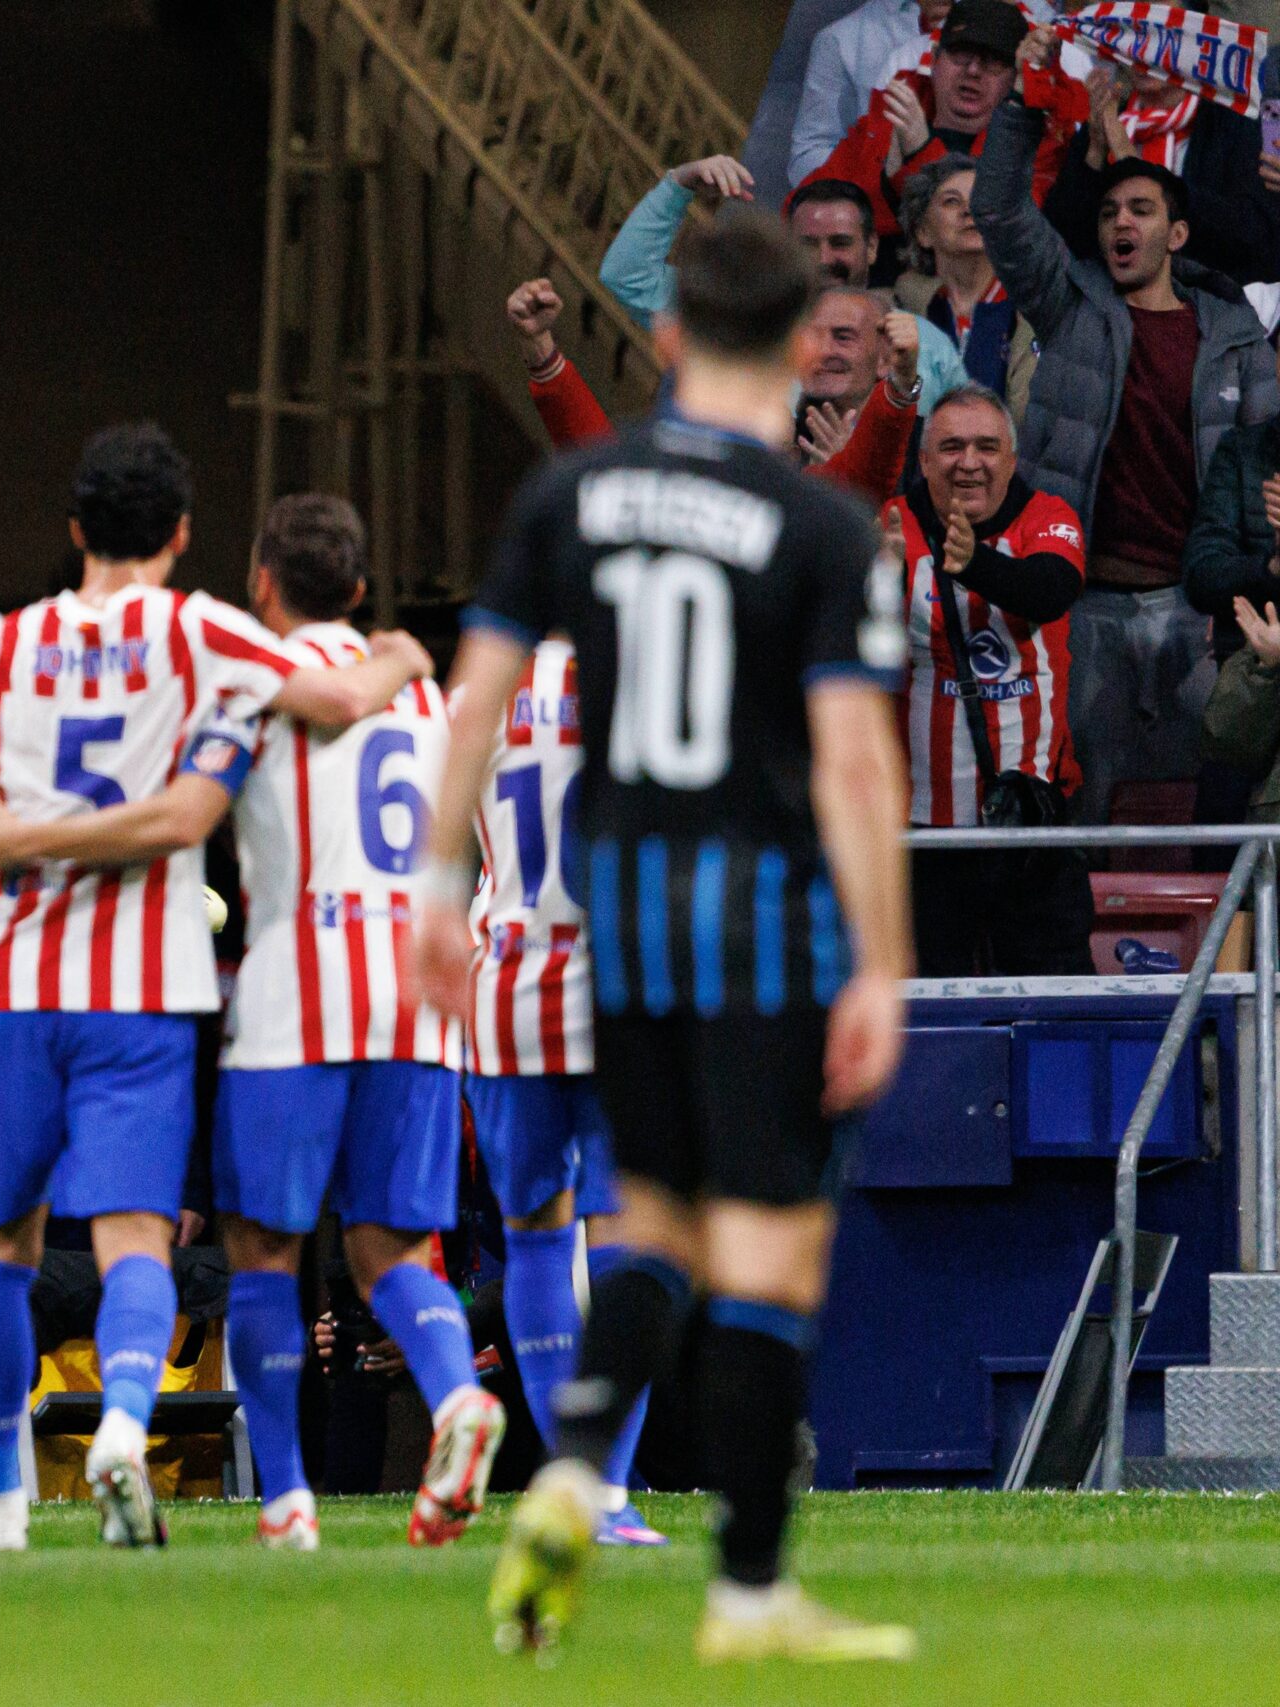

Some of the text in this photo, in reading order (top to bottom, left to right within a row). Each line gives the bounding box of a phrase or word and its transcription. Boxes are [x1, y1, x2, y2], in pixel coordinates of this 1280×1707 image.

[1192, 32, 1251, 94] DE
[591, 549, 736, 791] 10
[1006, 679, 1033, 697] AIR
[53, 715, 127, 810] 5
[357, 727, 430, 877] 6
